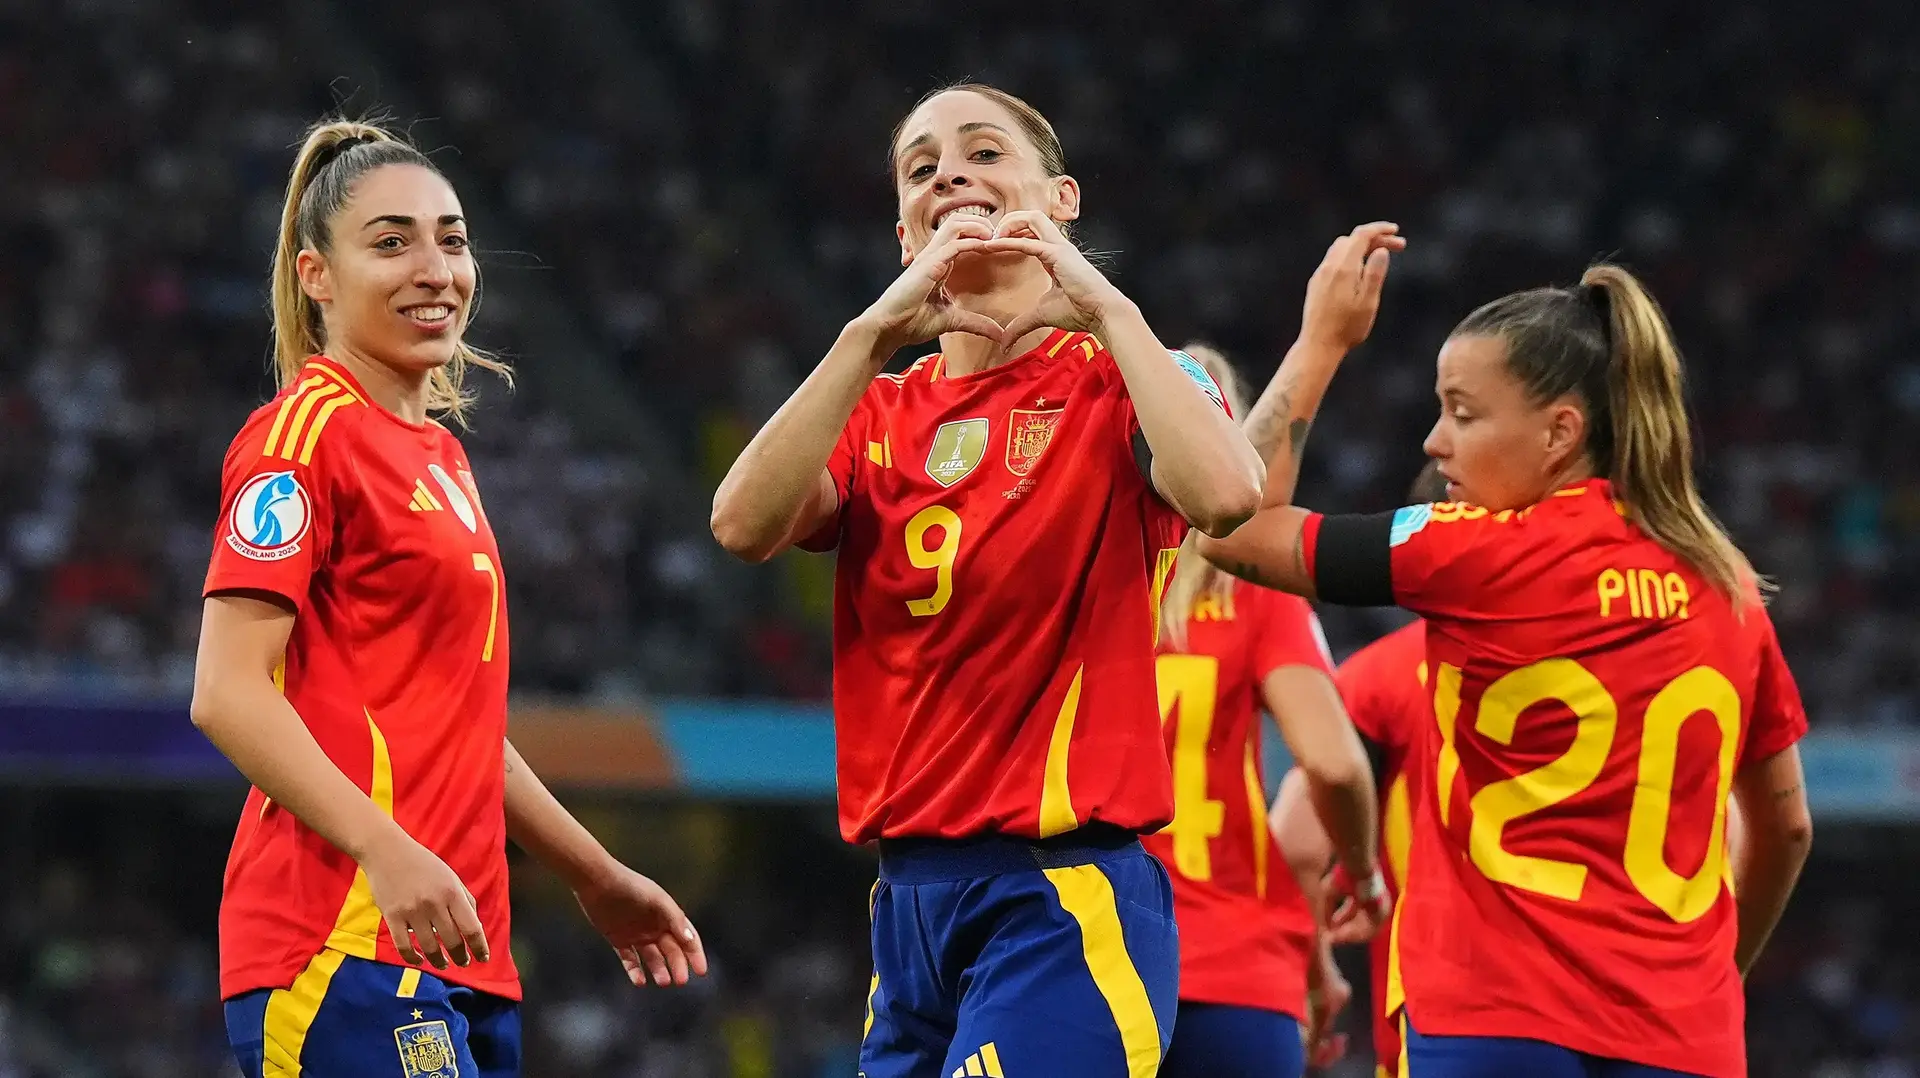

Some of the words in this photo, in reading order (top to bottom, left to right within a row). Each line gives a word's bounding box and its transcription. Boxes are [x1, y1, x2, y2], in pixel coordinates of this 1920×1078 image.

[939, 459, 964, 469] FIFA
[229, 536, 276, 558] SWITZERLAND
[278, 545, 297, 557] 2025
[905, 505, 962, 616] 9
[472, 553, 499, 662] 7
[1597, 567, 1690, 620] PINA
[1469, 657, 1742, 924] 20
